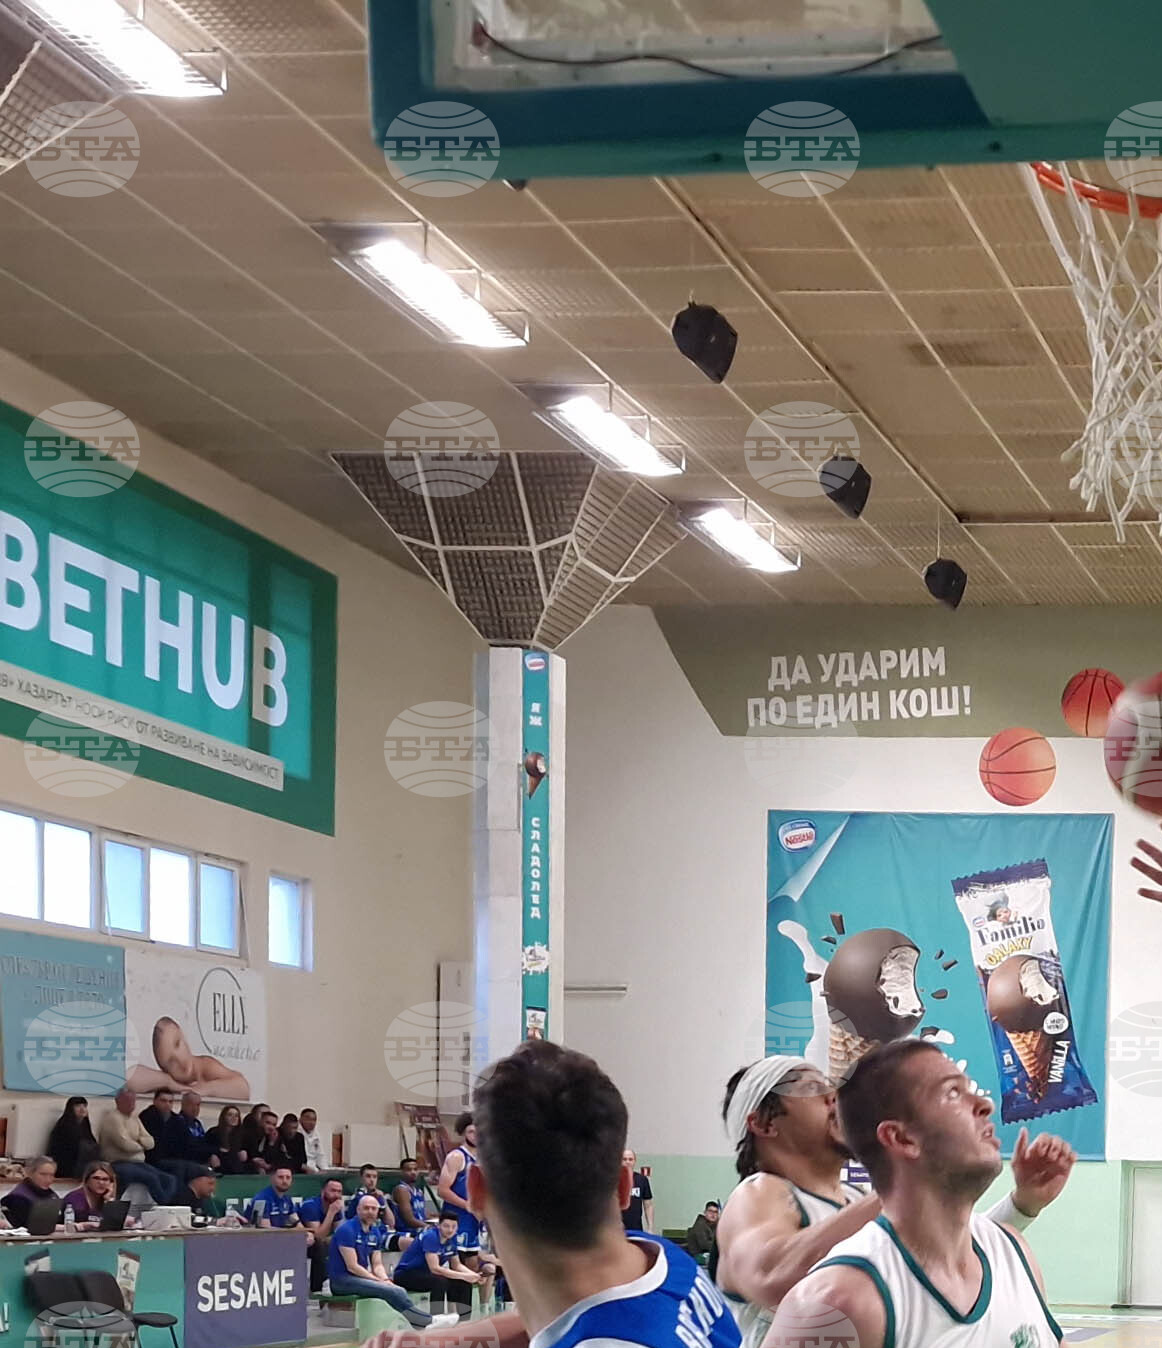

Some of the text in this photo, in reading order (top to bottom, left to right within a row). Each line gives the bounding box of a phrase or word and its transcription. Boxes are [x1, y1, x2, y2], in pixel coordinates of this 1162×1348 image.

[0, 509, 289, 728] BETHUB
[767, 646, 946, 692] ДА УДАРИМ
[747, 685, 971, 729] ПО ЕДИН КОШ!
[197, 1268, 297, 1313] SESAME
